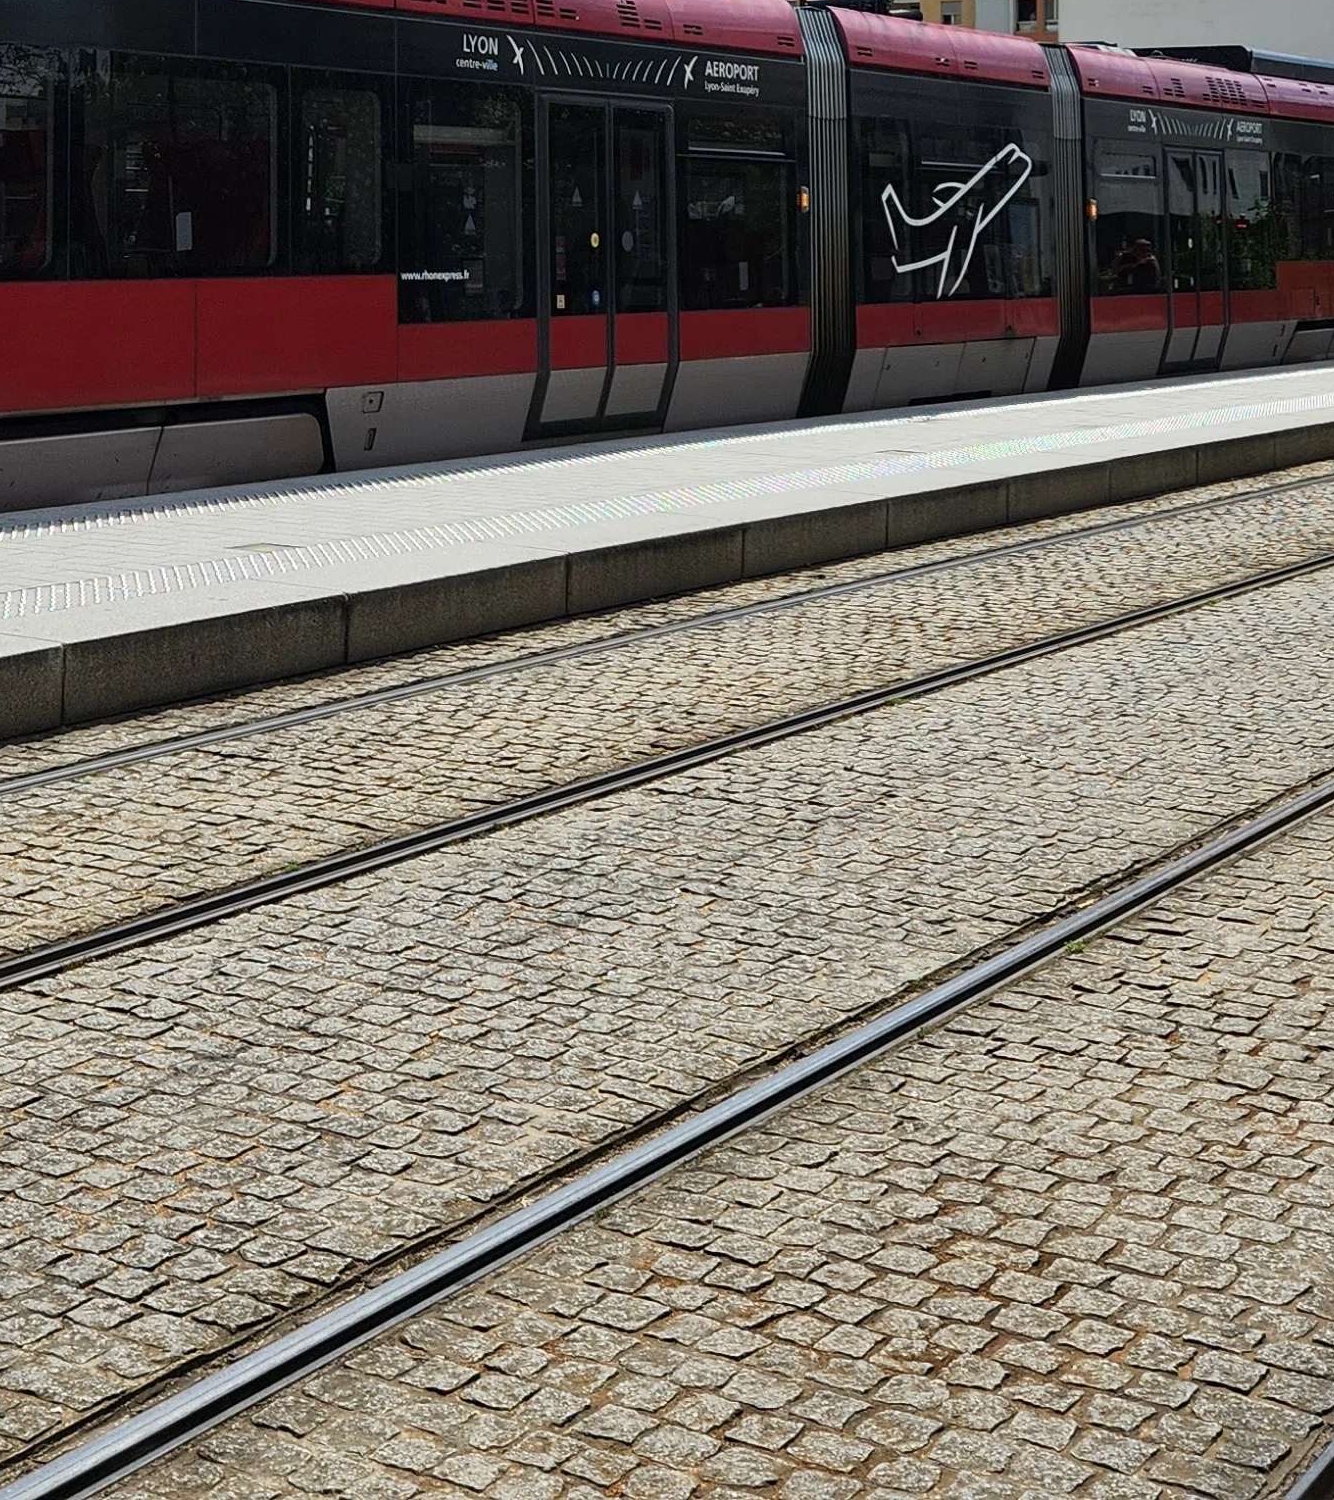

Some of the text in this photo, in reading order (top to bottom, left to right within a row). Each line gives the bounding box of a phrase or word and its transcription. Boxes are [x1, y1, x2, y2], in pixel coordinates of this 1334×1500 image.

[463, 34, 498, 55] LYON
[456, 58, 498, 71] centre-ville
[705, 60, 759, 81] AEROPORT
[704, 81, 736, 93] Lyon-Saint
[400, 269, 470, 282] www.rhonexpress.fr
